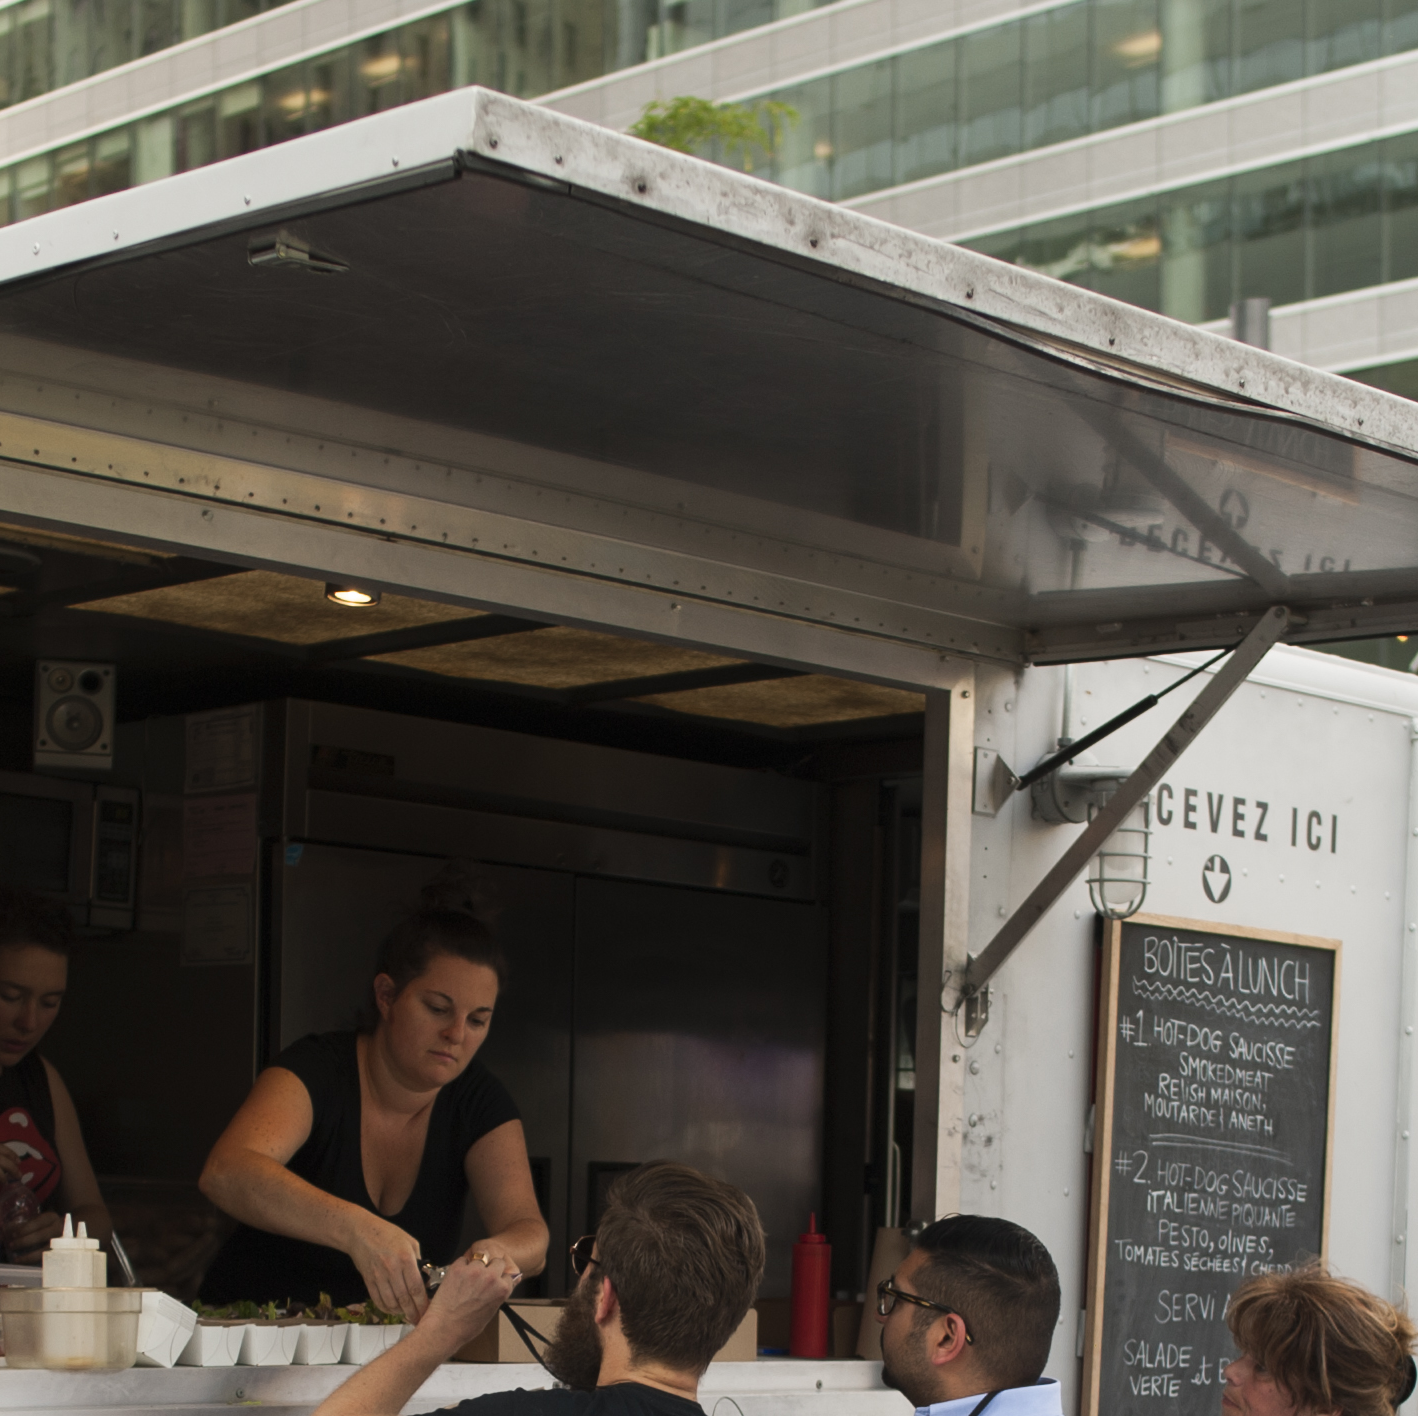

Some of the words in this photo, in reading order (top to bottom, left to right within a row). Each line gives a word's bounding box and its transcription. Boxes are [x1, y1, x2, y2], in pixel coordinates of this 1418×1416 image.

[1156, 782, 1269, 843] CEVEZ
[1290, 806, 1338, 854] ICI
[1143, 935, 1215, 986] BOÎTES
[1238, 949, 1310, 1005] LUNCH
[1153, 1014, 1223, 1053] HOT-DOG
[1228, 1031, 1296, 1069] SAUCISSE
[1144, 1092, 1217, 1128] MOUTARDE
[1228, 1110, 1274, 1136] ANETH
[1157, 1159, 1230, 1196] HOT-DOG
[1231, 1169, 1308, 1203] SAUCISSE
[1147, 1189, 1230, 1220] ITALIENNE
[1231, 1202, 1297, 1229] PIQUANTE
[1114, 1238, 1180, 1269] TOMATES
[1157, 1218, 1215, 1254] PESTO,
[1154, 1289, 1216, 1325] SERVI
[1122, 1338, 1193, 1369] SALADE
[1129, 1373, 1182, 1398] VERTE
